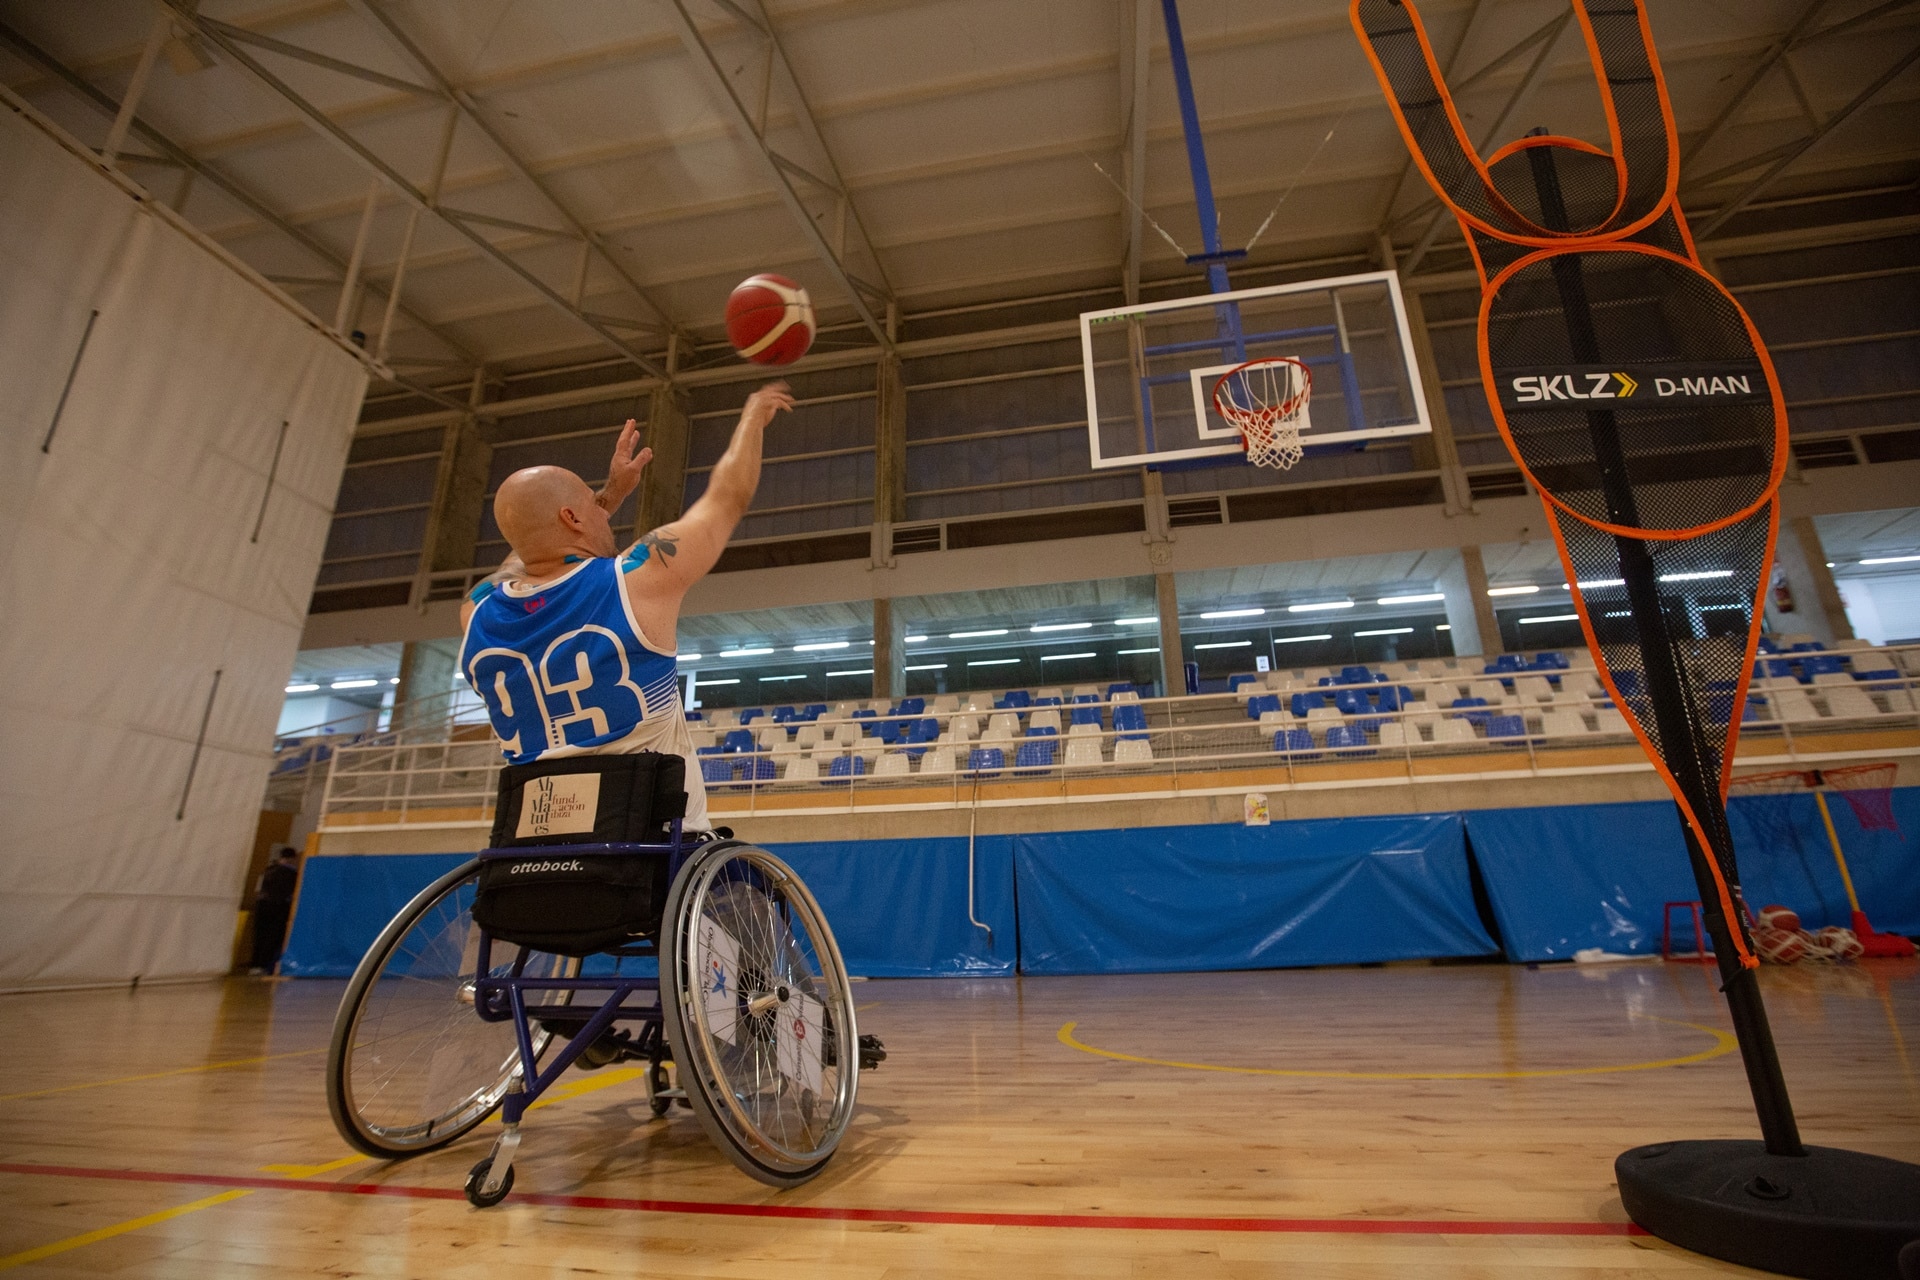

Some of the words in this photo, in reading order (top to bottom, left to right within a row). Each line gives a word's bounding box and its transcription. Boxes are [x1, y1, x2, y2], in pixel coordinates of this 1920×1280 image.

[1512, 373, 1615, 402] SKLZ
[1654, 375, 1751, 397] D-MAN
[469, 624, 648, 756] 93
[534, 824, 549, 835] es
